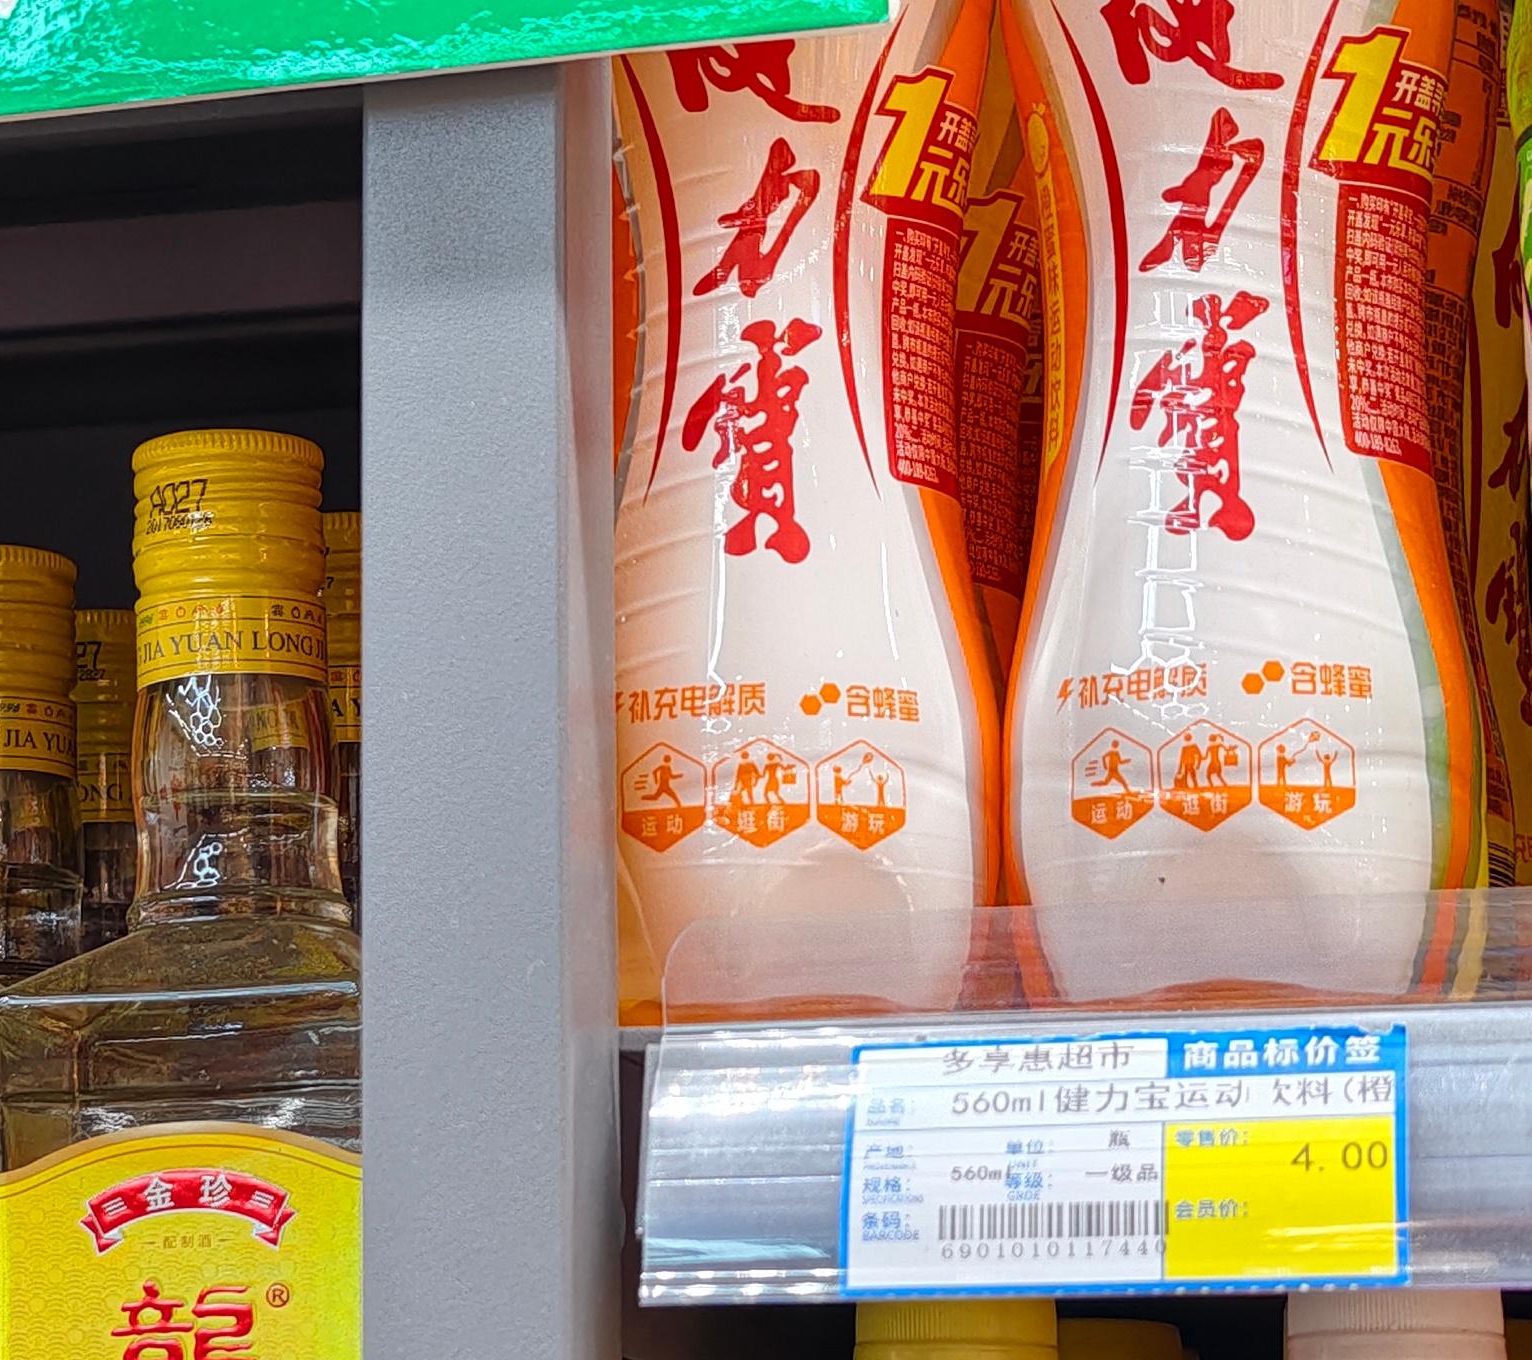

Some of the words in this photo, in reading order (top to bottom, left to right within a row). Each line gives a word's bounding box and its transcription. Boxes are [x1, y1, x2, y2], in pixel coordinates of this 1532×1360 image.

[148, 478, 210, 518] A027
[169, 630, 244, 656] YUAN
[250, 630, 314, 658] LONG
[1290, 660, 1373, 701] 含蜂蜜
[845, 684, 921, 722] 含蜂蜜
[1090, 798, 1134, 827] 运动
[1283, 790, 1333, 815] 游玩
[641, 812, 684, 838] 运动
[841, 810, 886, 835] 游玩
[942, 1041, 1135, 1076] 多享惠超市
[1183, 1035, 1382, 1070] 商品标价签
[1175, 1128, 1249, 1148] 零售价：
[1290, 1140, 1389, 1173] 4.00
[1085, 1163, 1159, 1183] 一级品
[1174, 1199, 1249, 1220] 会员价：
